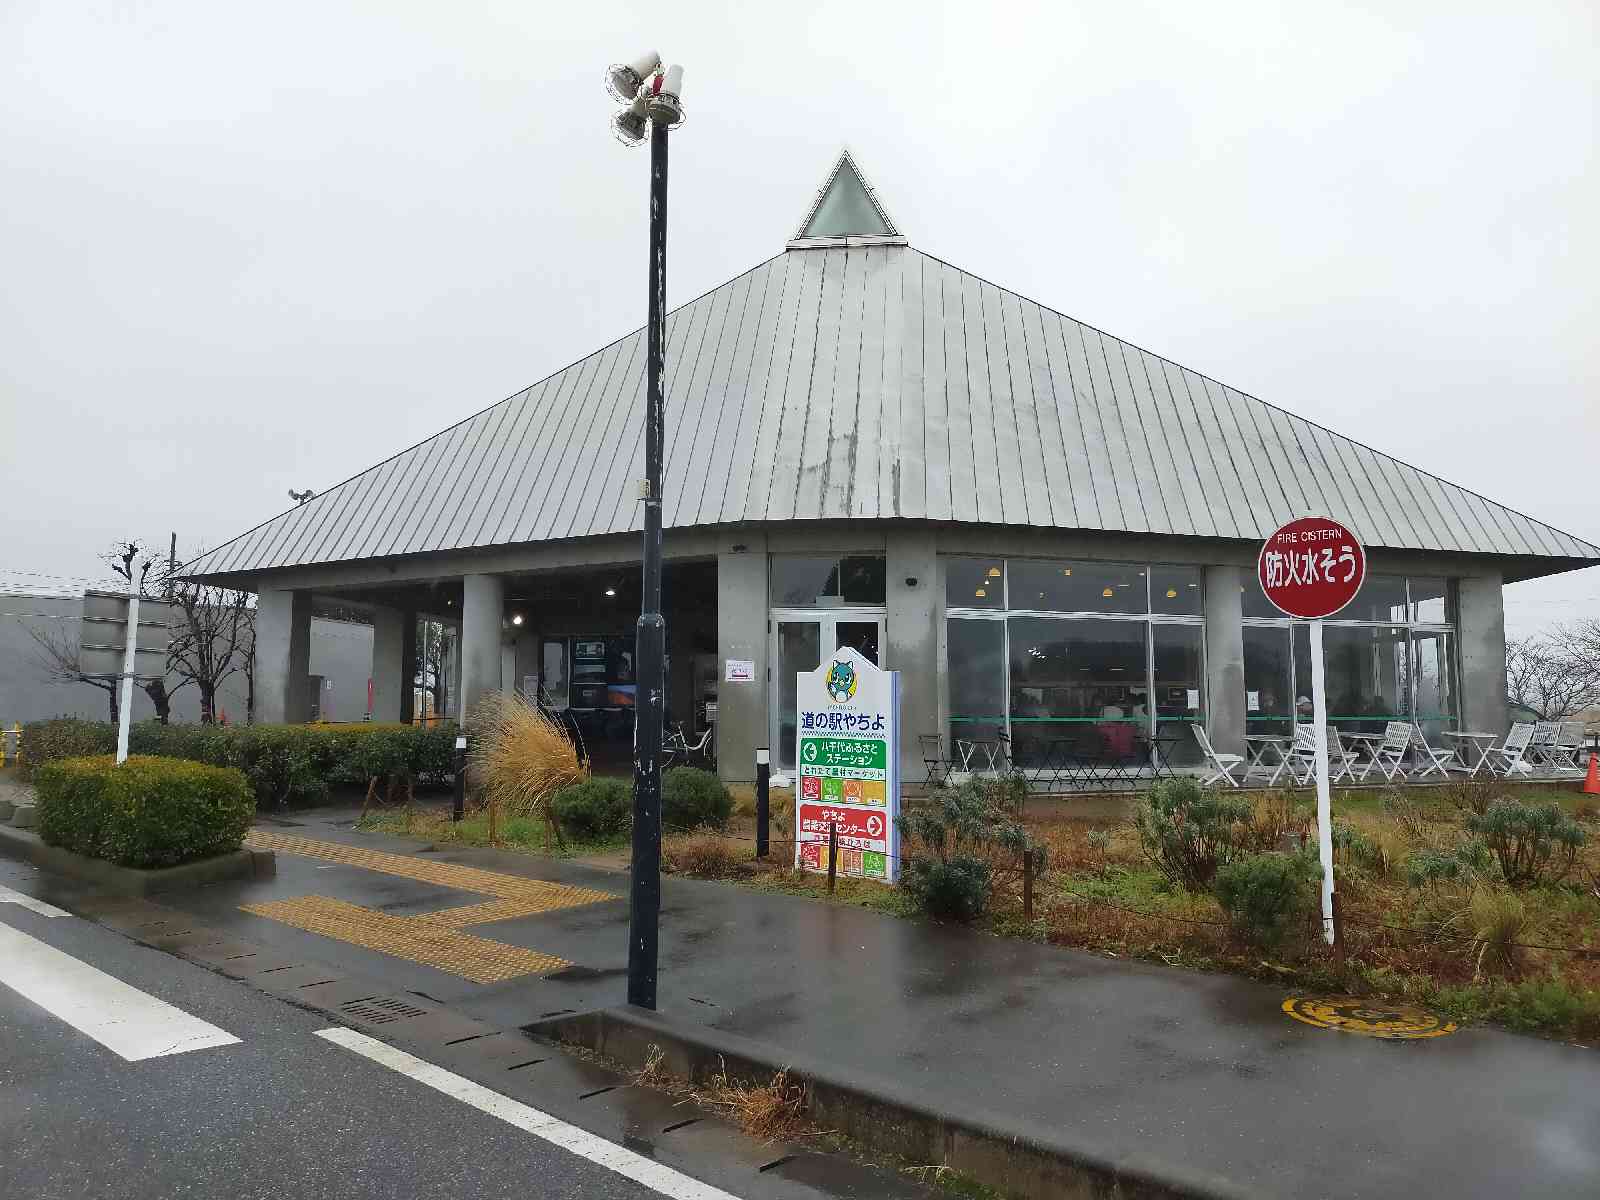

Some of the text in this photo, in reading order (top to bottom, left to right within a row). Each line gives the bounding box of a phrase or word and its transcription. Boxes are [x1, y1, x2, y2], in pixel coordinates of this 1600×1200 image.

[1277, 529, 1342, 544] FIRE CISTERN
[1265, 546, 1356, 588] 防火水そう
[802, 711, 885, 730] 道の駅やちよ
[822, 742, 878, 755] 八千代ふるさと
[826, 754, 872, 766] ステーション
[822, 810, 846, 822] やちよ
